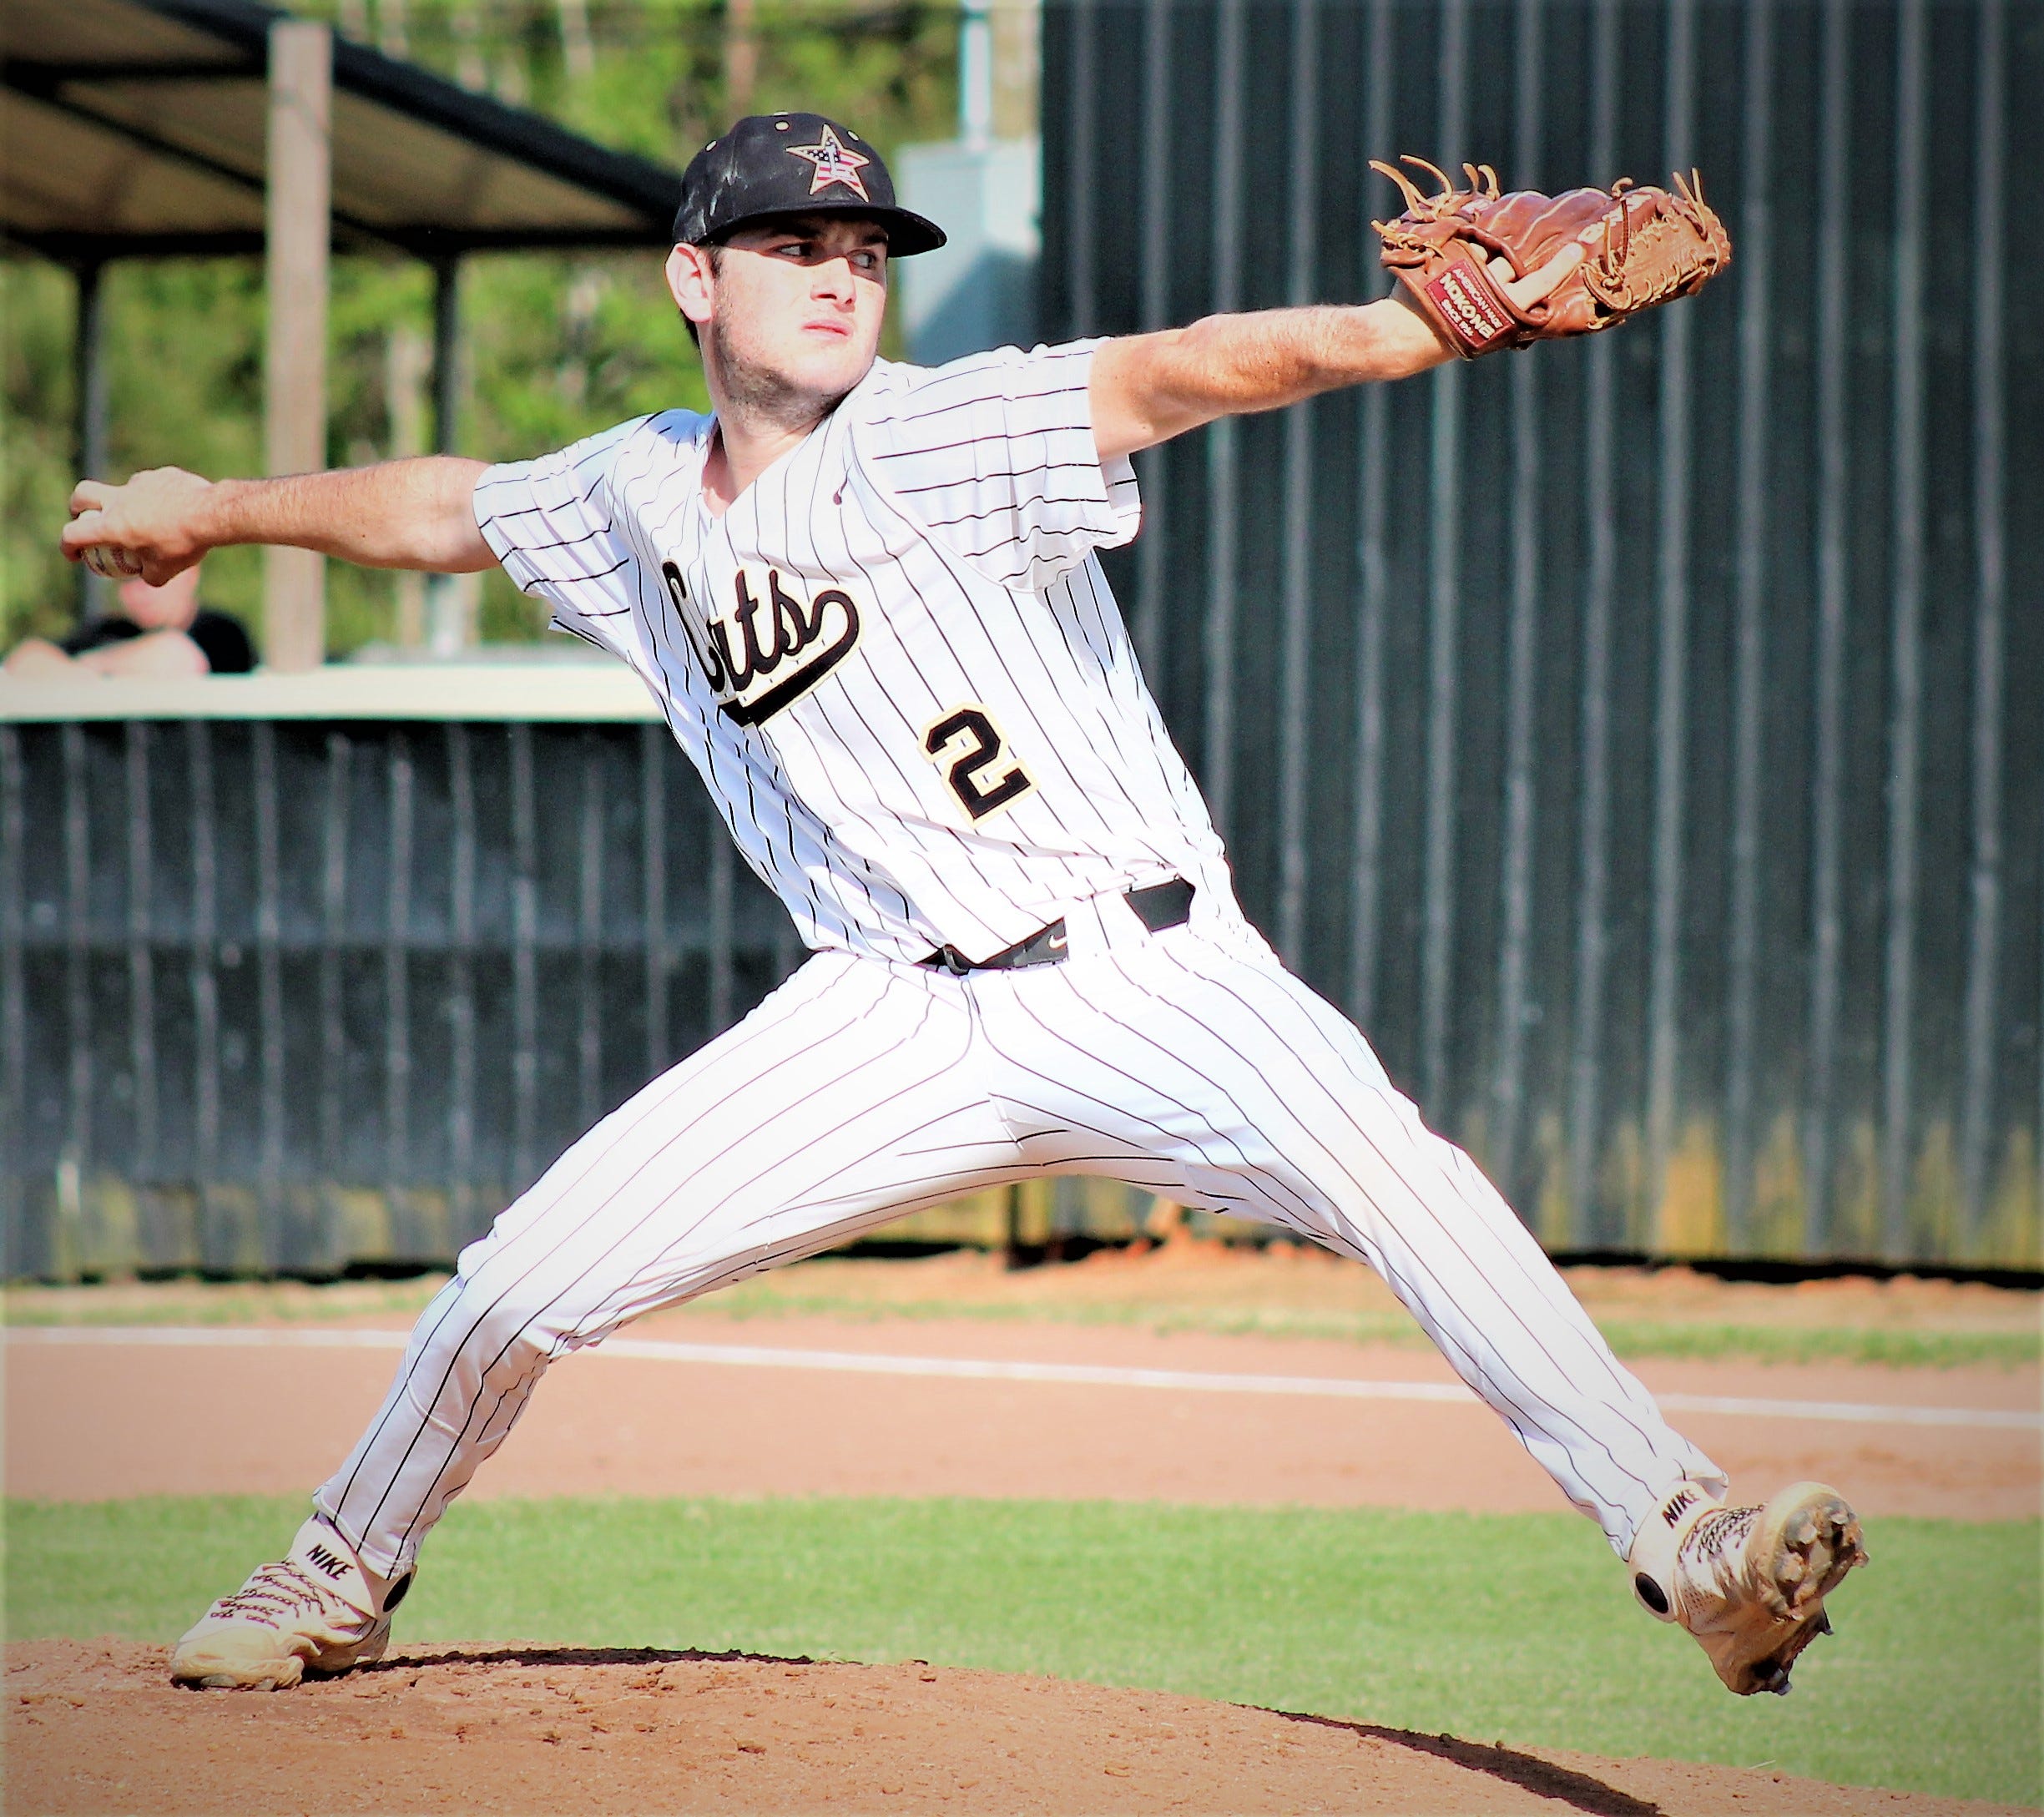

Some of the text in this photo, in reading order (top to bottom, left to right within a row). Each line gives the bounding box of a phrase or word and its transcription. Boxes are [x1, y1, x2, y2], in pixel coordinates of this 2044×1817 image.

[1453, 268, 1504, 329] AMERICAN MADE
[923, 706, 1033, 822] 2
[1662, 1488, 1701, 1530] NIKE
[305, 1543, 355, 1581] NIKE
